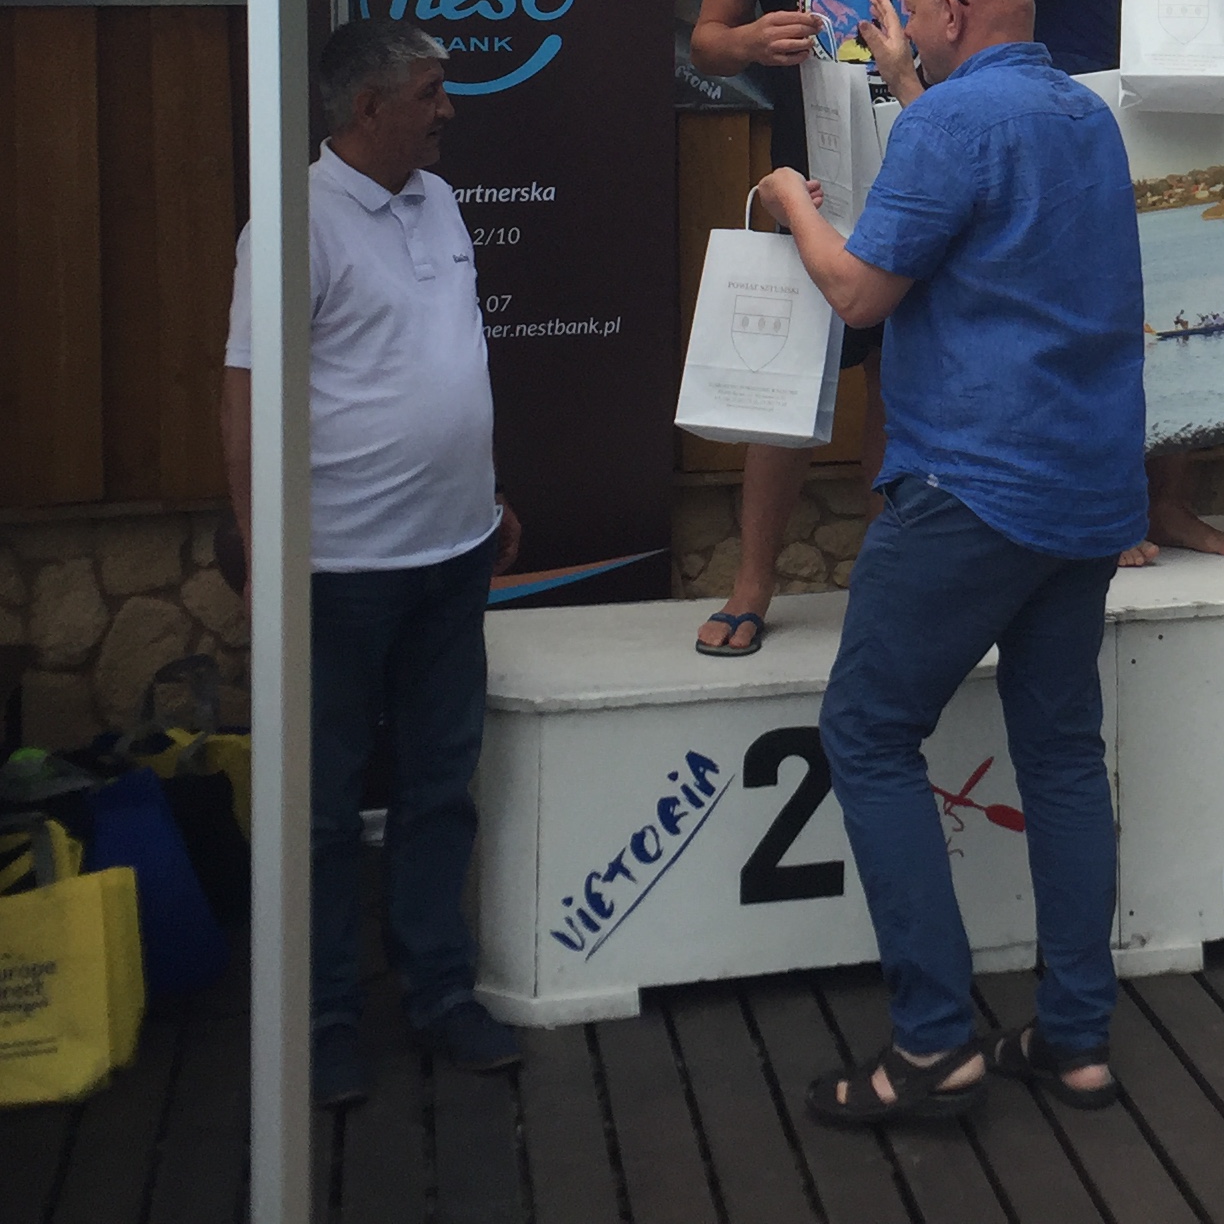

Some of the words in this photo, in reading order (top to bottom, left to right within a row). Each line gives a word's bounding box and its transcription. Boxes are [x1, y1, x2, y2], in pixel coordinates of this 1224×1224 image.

[451, 181, 556, 204] artnerska
[486, 294, 513, 313] 07
[740, 725, 845, 905] 2
